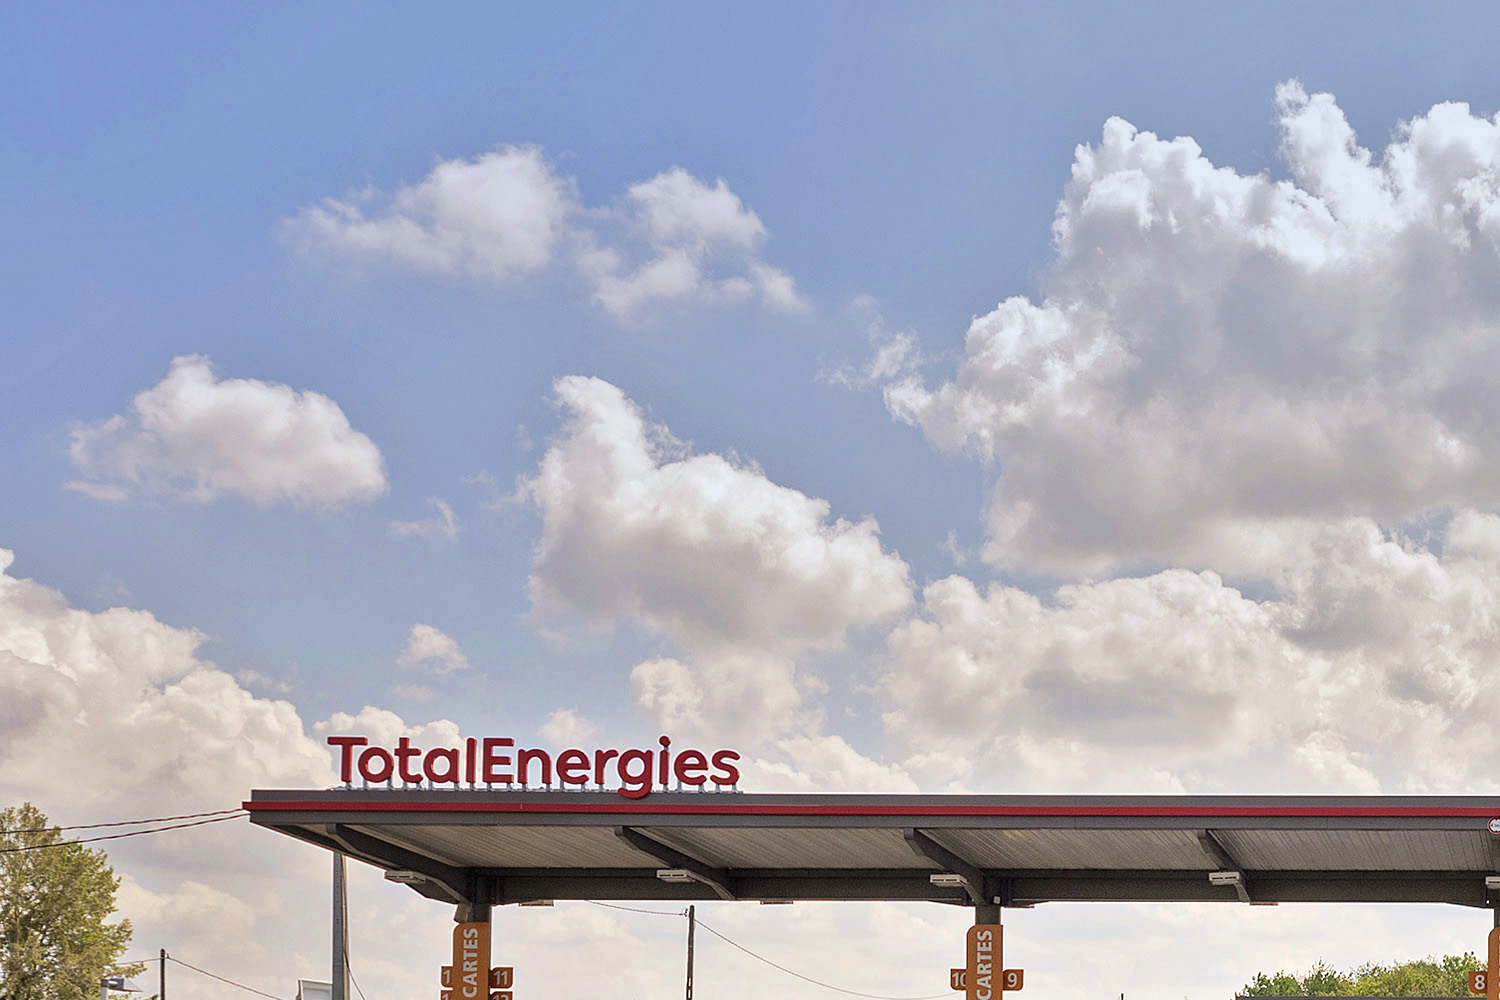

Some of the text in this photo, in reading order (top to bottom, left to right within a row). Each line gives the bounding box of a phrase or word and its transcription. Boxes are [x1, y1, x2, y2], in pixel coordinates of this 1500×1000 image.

[327, 735, 741, 799] TotalEnergies
[463, 928, 478, 998] CARTES
[493, 970, 508, 986] 11
[976, 930, 992, 1000] CARTES
[1007, 972, 1018, 988] 9
[1474, 974, 1486, 990] 8
